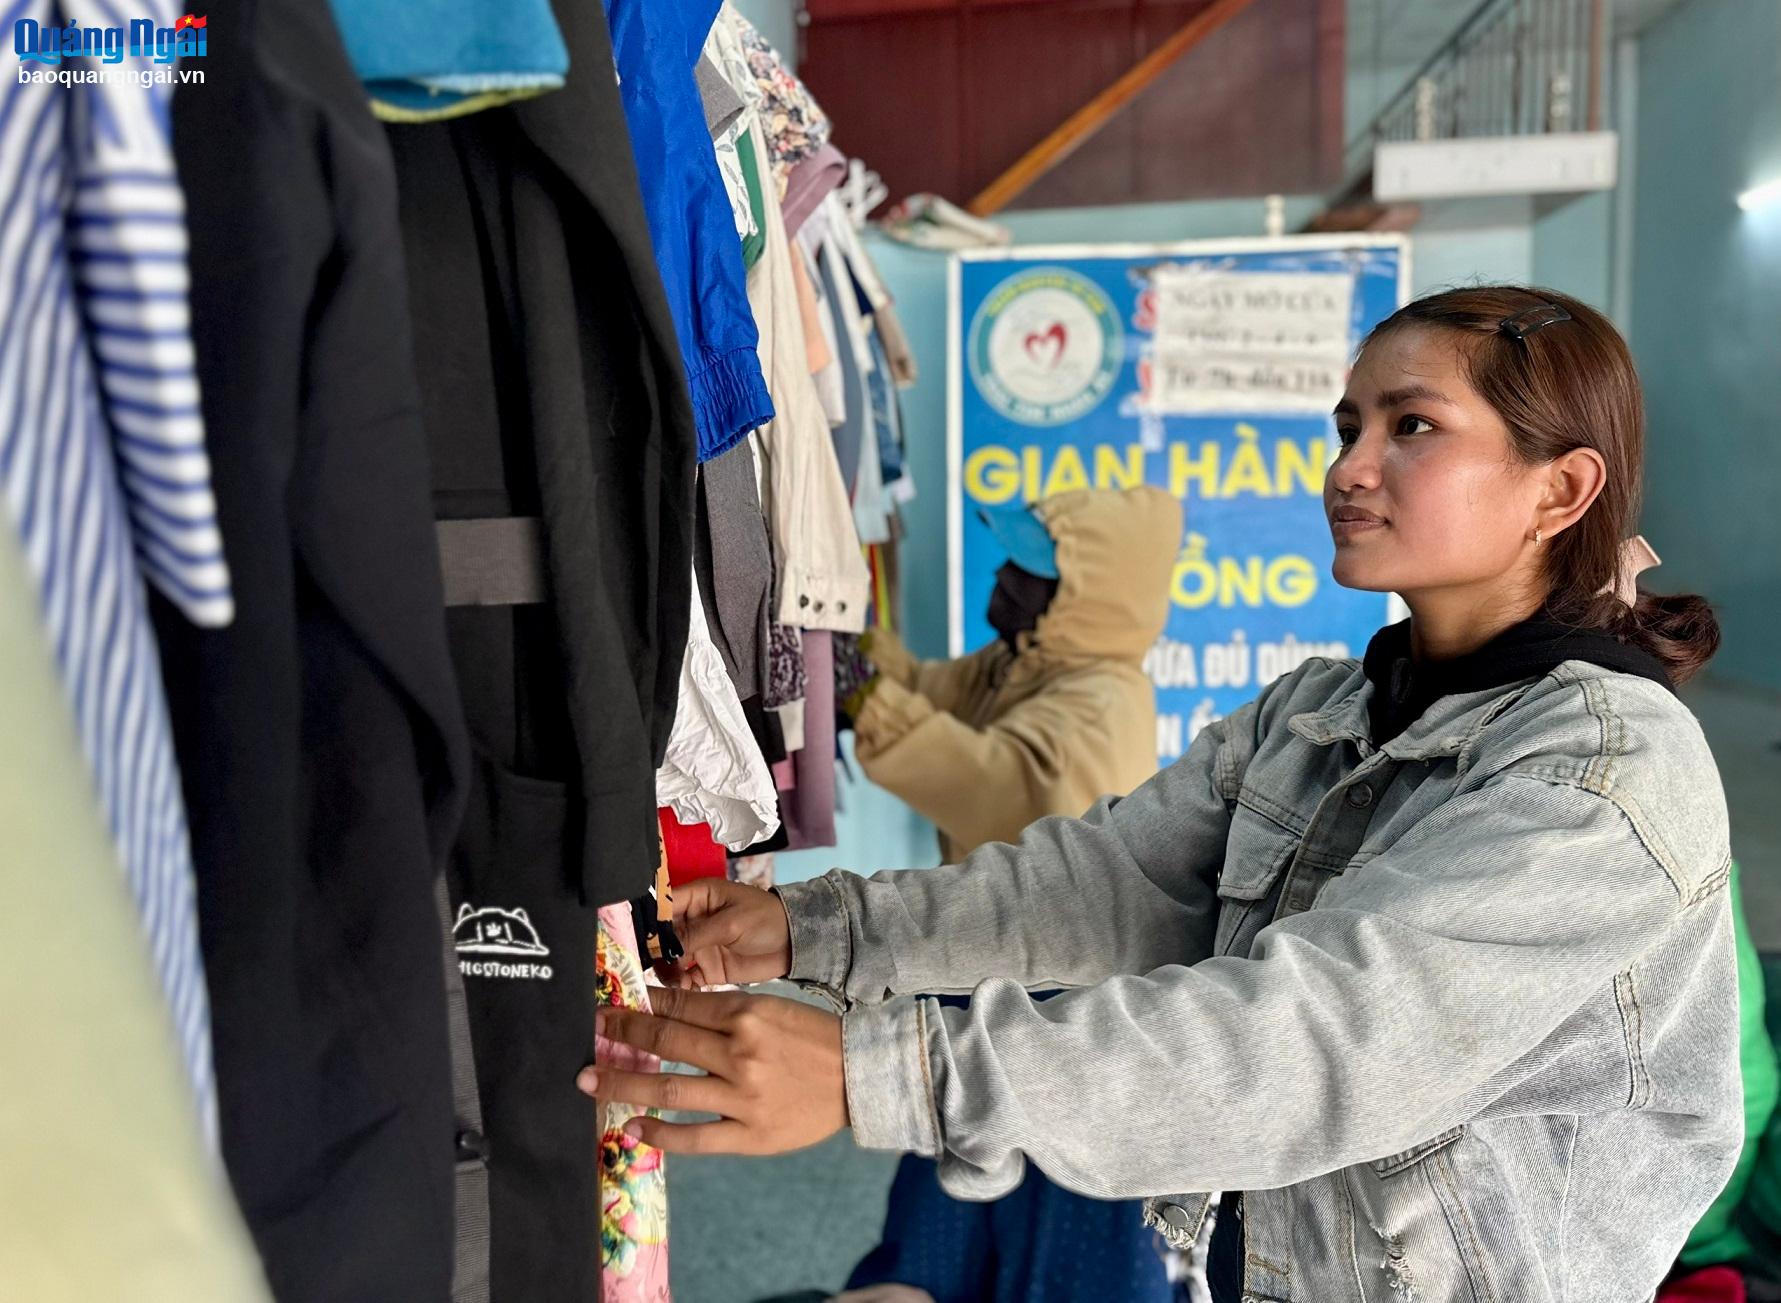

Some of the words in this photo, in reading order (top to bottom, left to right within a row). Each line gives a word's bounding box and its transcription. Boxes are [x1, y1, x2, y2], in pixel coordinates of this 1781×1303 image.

[964, 444, 1145, 505] GIAN
[1167, 423, 1339, 499] HÀN
[1168, 532, 1317, 608] ỒNG
